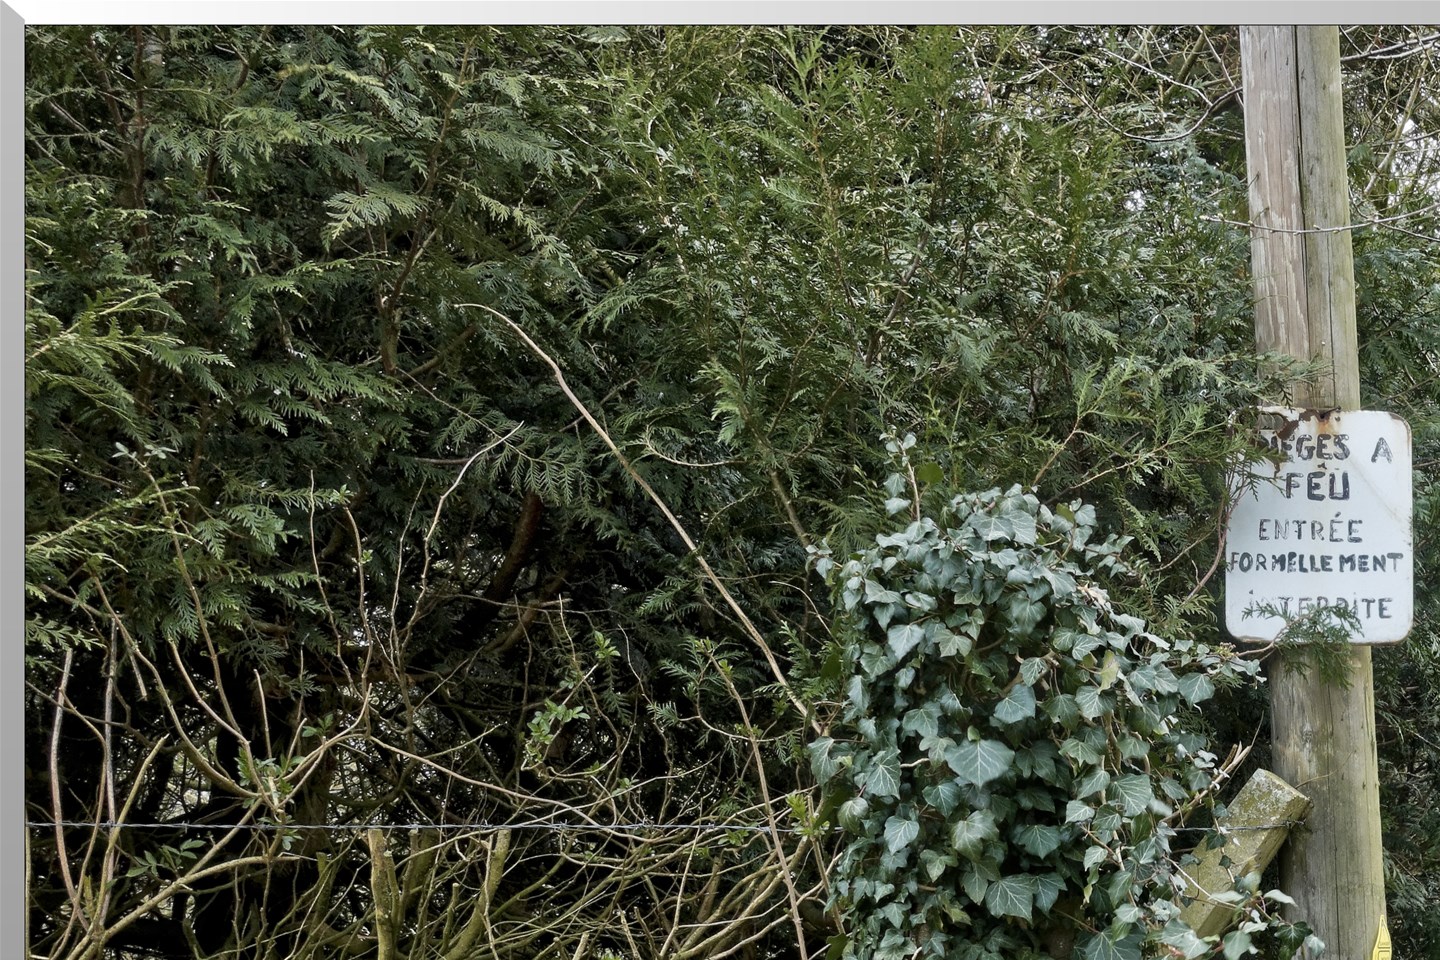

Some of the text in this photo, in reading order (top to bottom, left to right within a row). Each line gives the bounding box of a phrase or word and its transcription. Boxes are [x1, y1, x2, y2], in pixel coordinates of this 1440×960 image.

[1371, 437, 1394, 463] A
[1258, 511, 1364, 543] ENTRÉE
[1230, 551, 1404, 574] FORMELLEMENT
